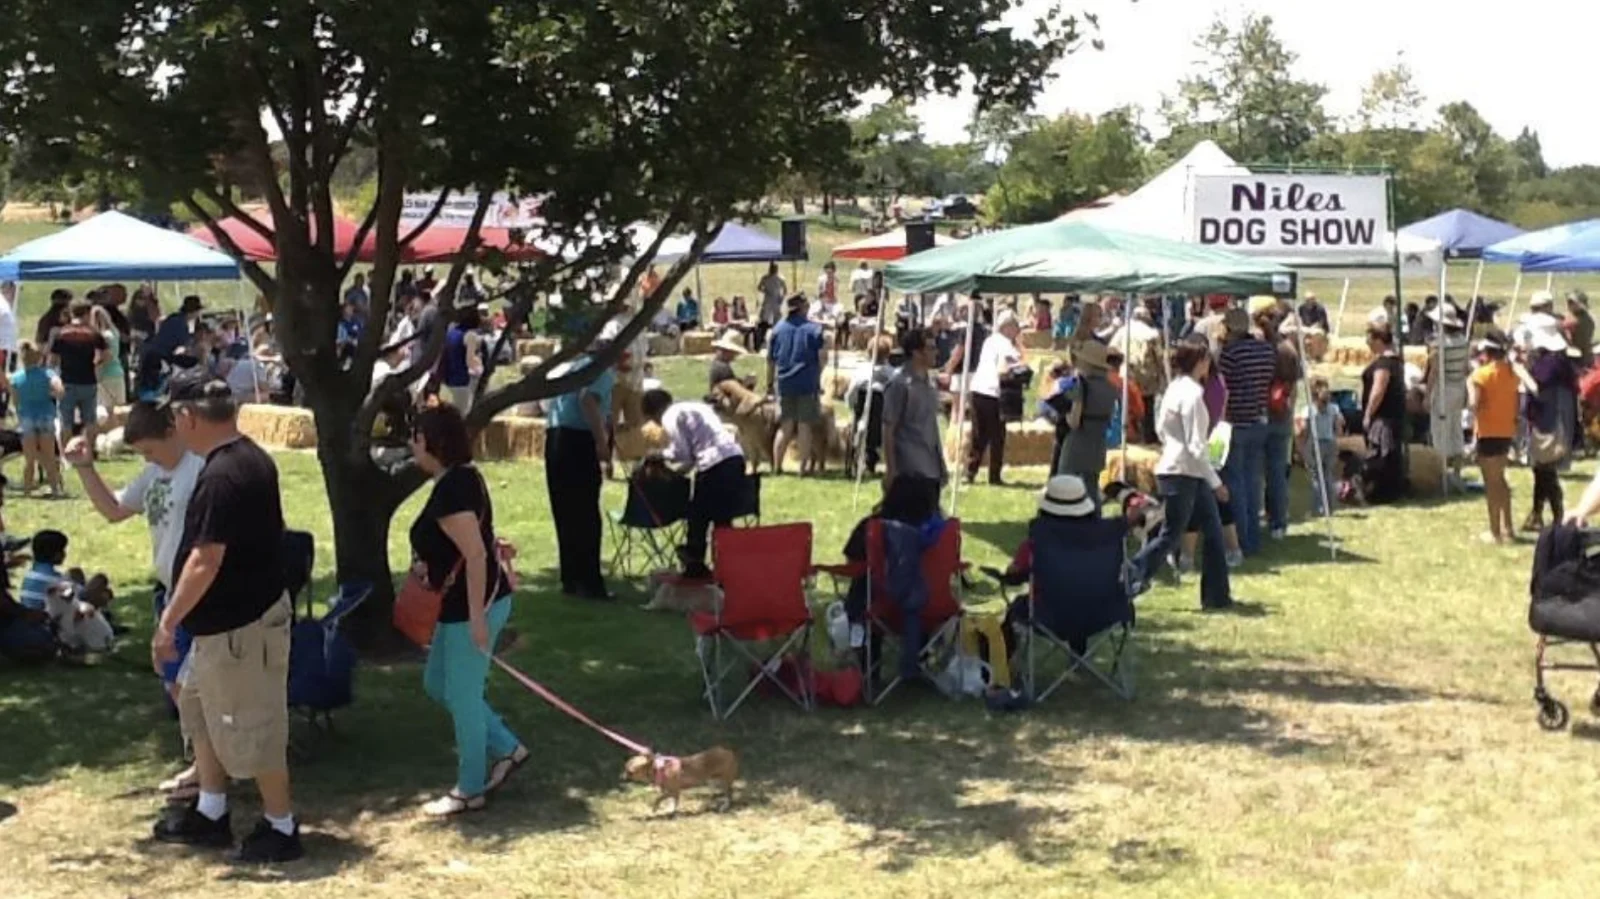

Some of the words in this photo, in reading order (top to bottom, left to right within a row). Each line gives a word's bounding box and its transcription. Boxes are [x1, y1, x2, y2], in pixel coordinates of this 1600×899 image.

[1231, 182, 1346, 212] Niles
[1200, 218, 1266, 245] DOG
[1280, 218, 1375, 245] SHOW
